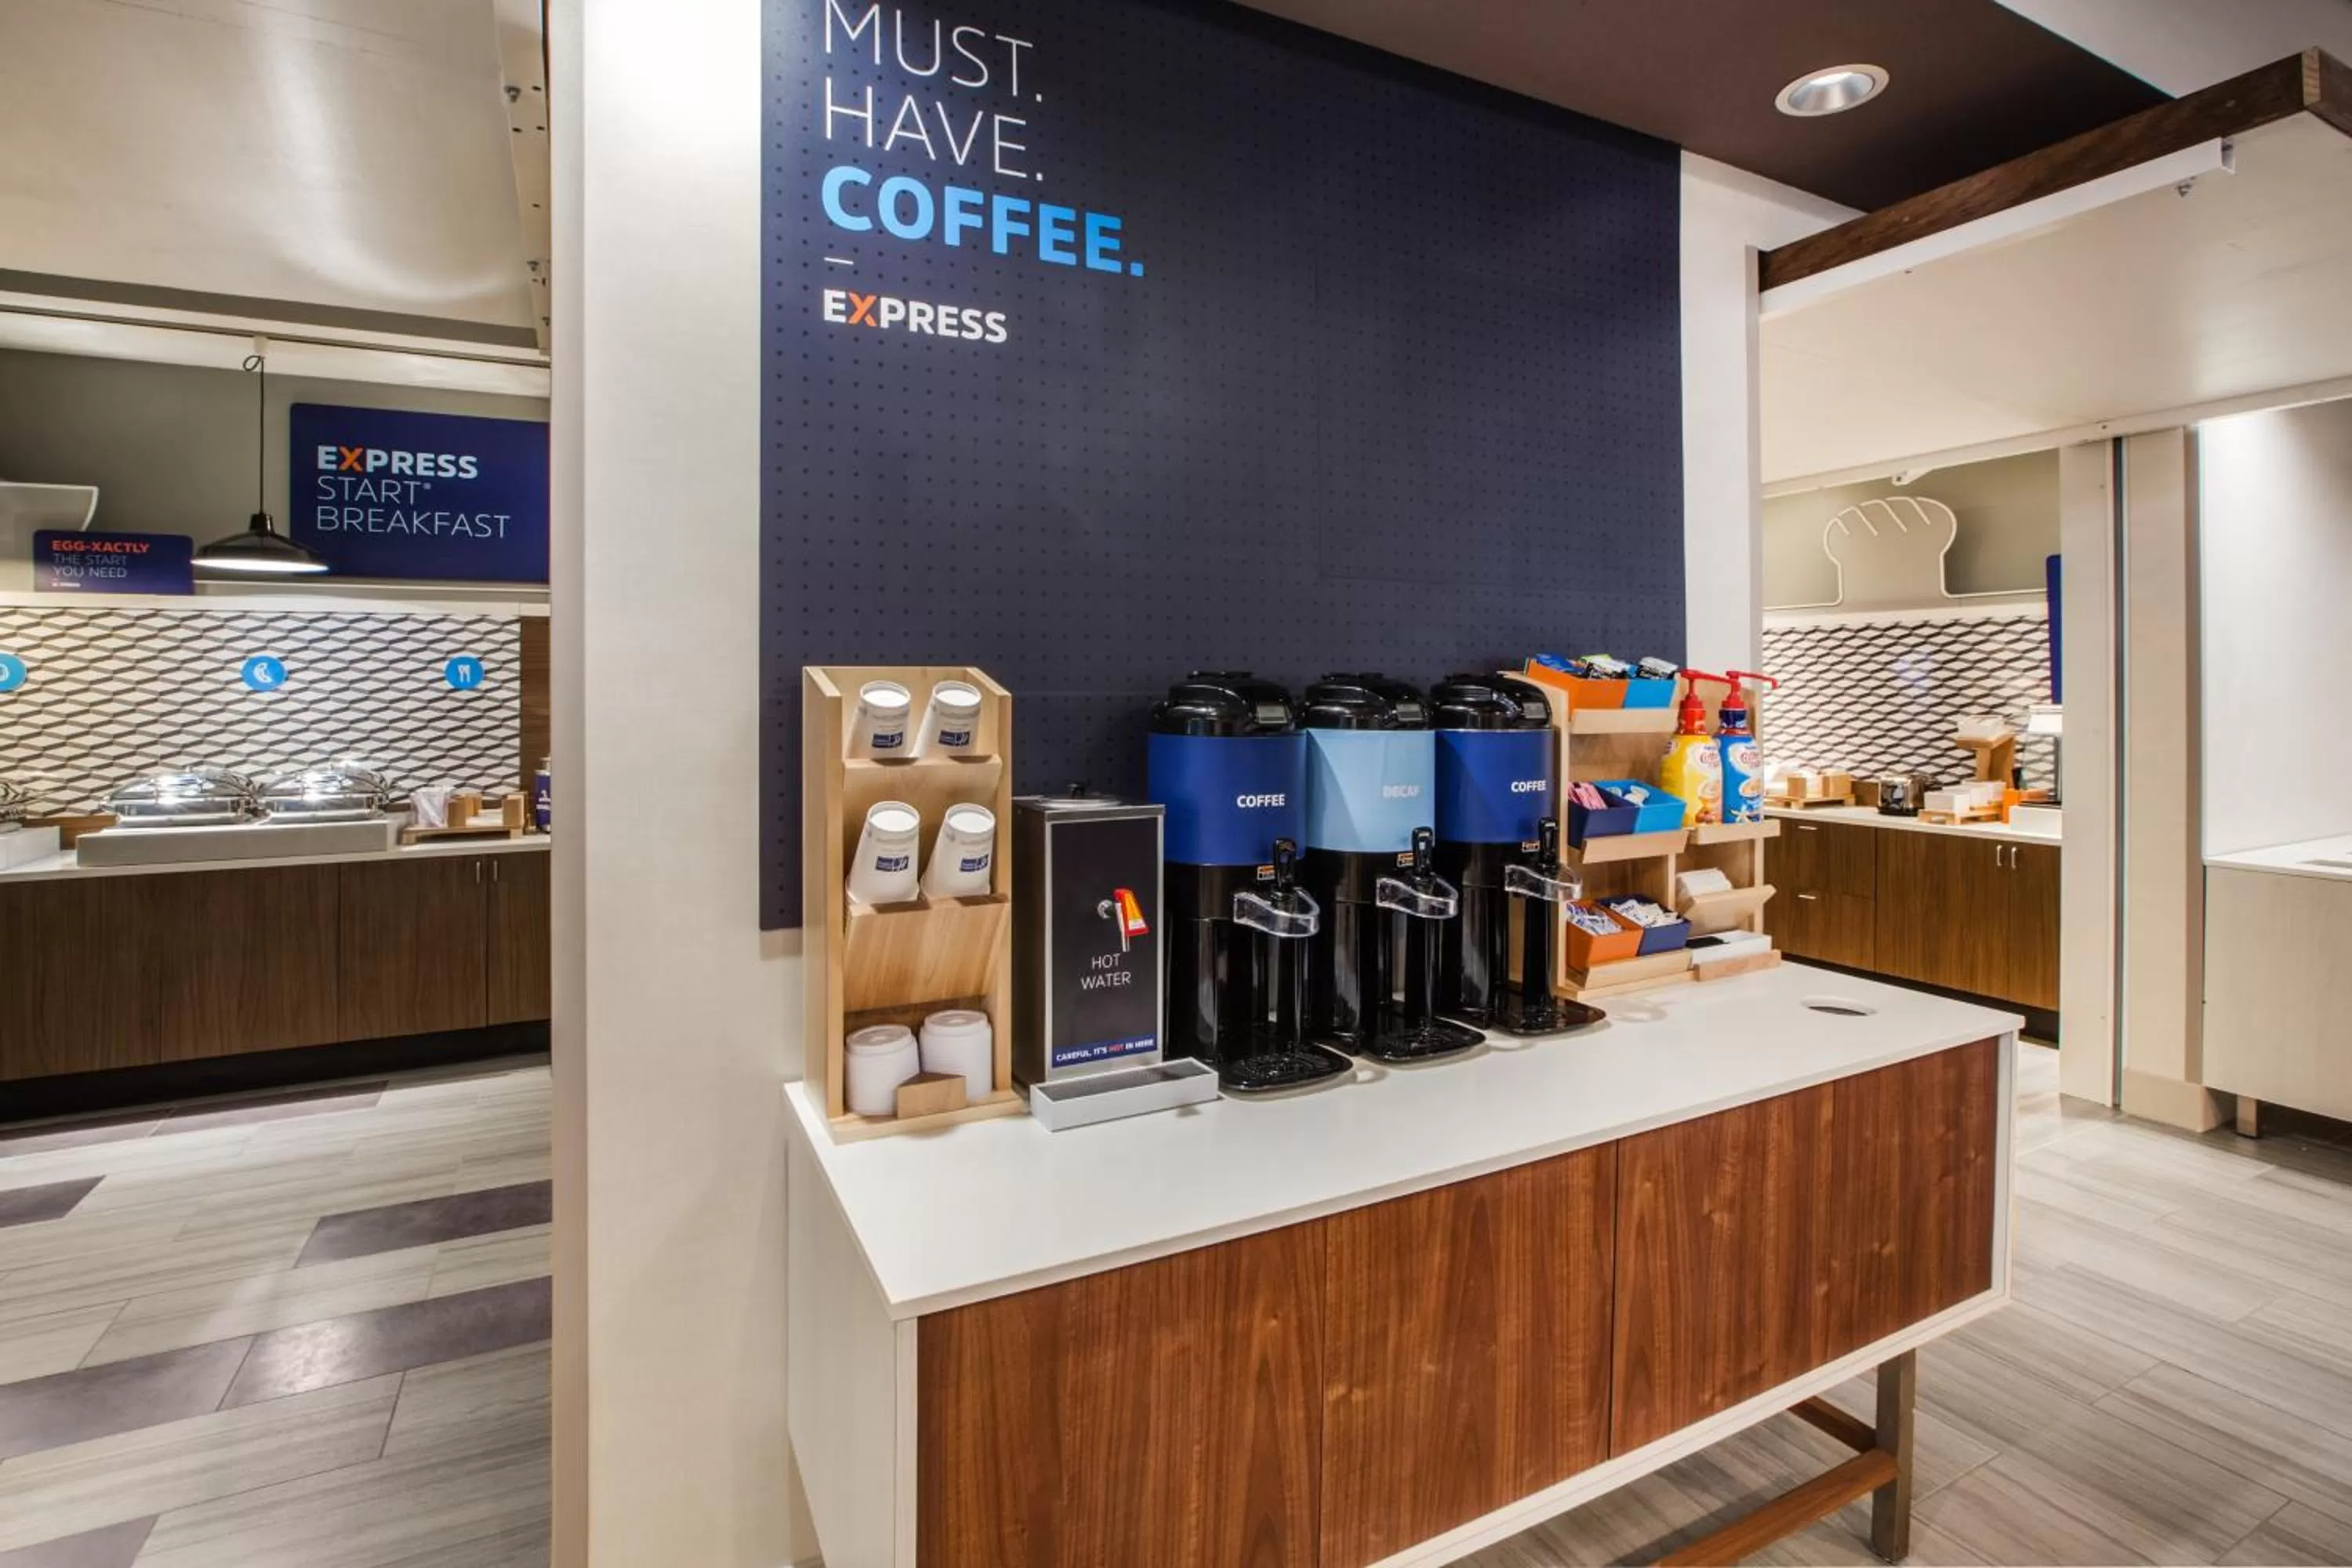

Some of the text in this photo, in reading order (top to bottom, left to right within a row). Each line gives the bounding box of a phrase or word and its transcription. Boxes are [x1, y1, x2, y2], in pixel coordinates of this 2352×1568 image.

[825, 0, 1042, 102] MUST.
[826, 76, 1043, 181] HAVE.
[821, 165, 1144, 277] COFFEE.
[824, 289, 1007, 343] EXPRESS
[318, 445, 478, 479] EXPRESS
[317, 506, 511, 539] BREAKFAST
[52, 539, 151, 553] EGG-XACTLY
[53, 553, 127, 565] THE START
[53, 565, 128, 578] YOU NEED
[1382, 785, 1421, 798] DECAF
[1511, 780, 1547, 793] COFFEE
[1236, 793, 1285, 808] COFFEE
[1091, 953, 1120, 970] HOT
[1080, 971, 1131, 990] WATER
[1134, 1039, 1154, 1048] HERE
